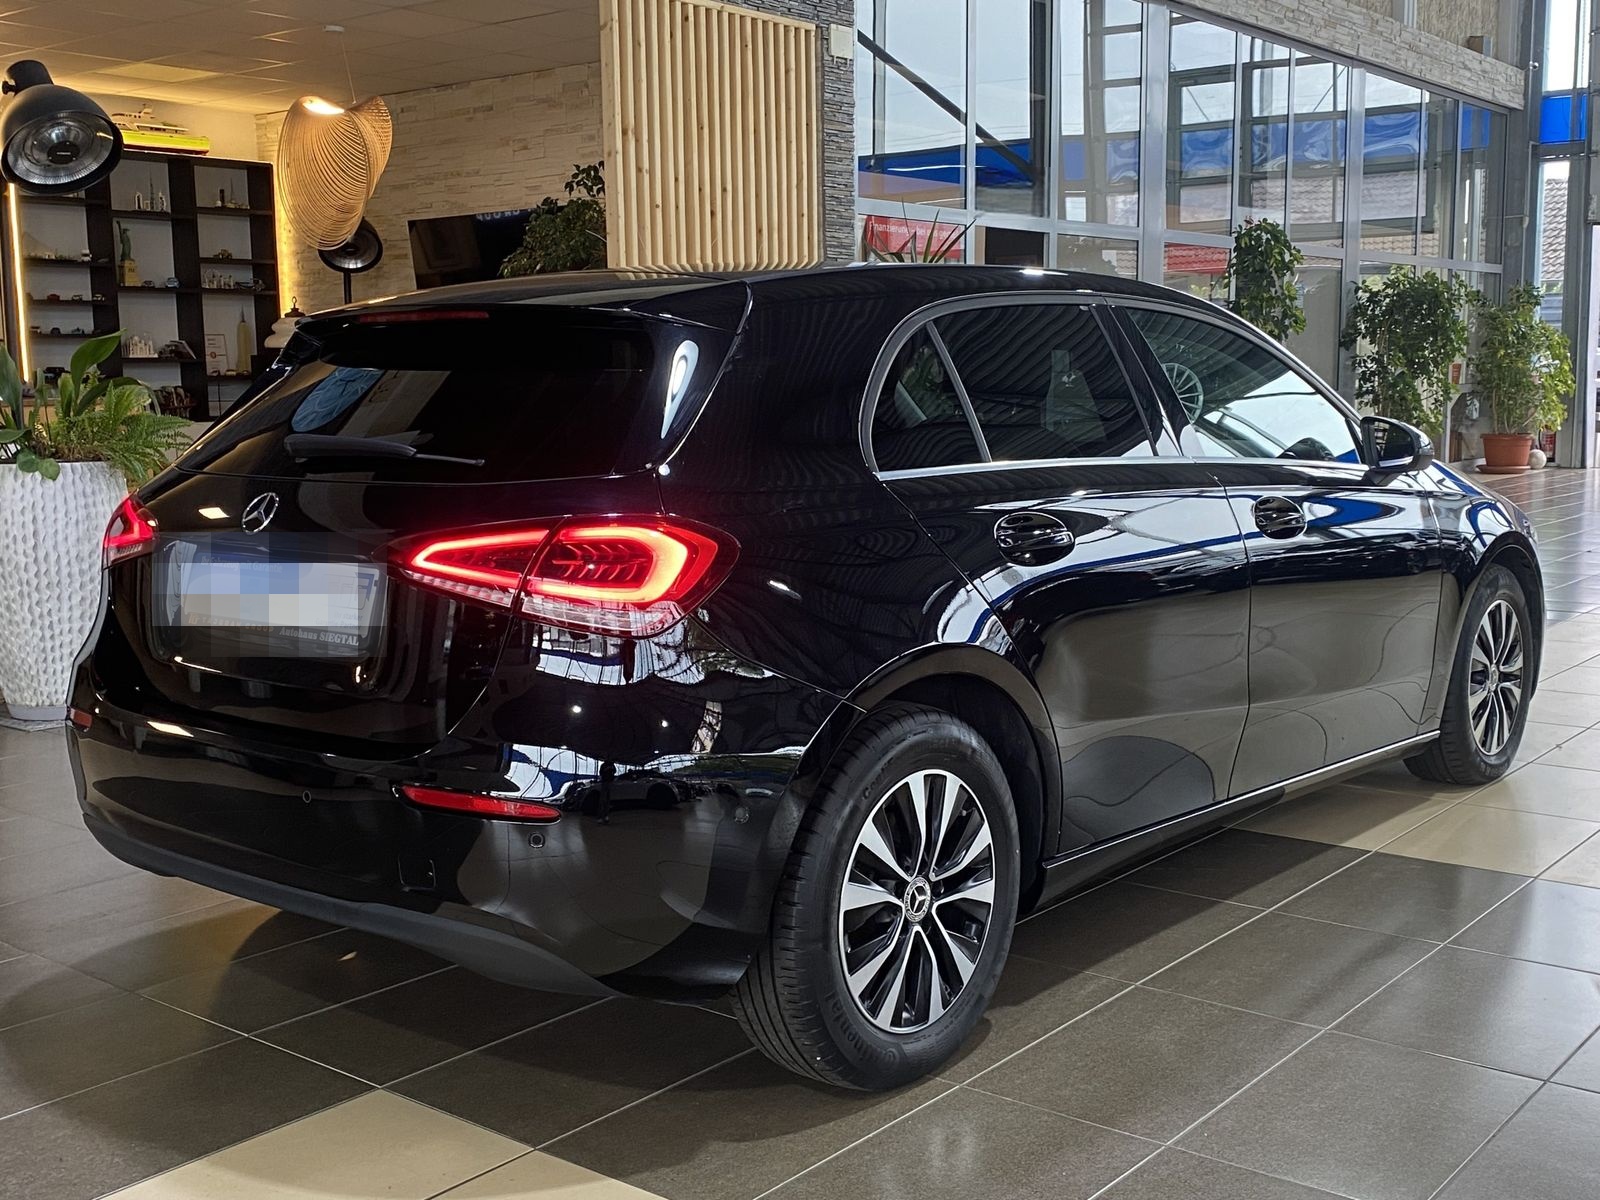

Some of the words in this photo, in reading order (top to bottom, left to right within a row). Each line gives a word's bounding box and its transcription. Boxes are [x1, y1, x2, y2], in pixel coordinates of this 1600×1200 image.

[252, 560, 283, 574] Garantie
[279, 626, 318, 640] Autohaus
[319, 631, 360, 646] SIEGTAL
